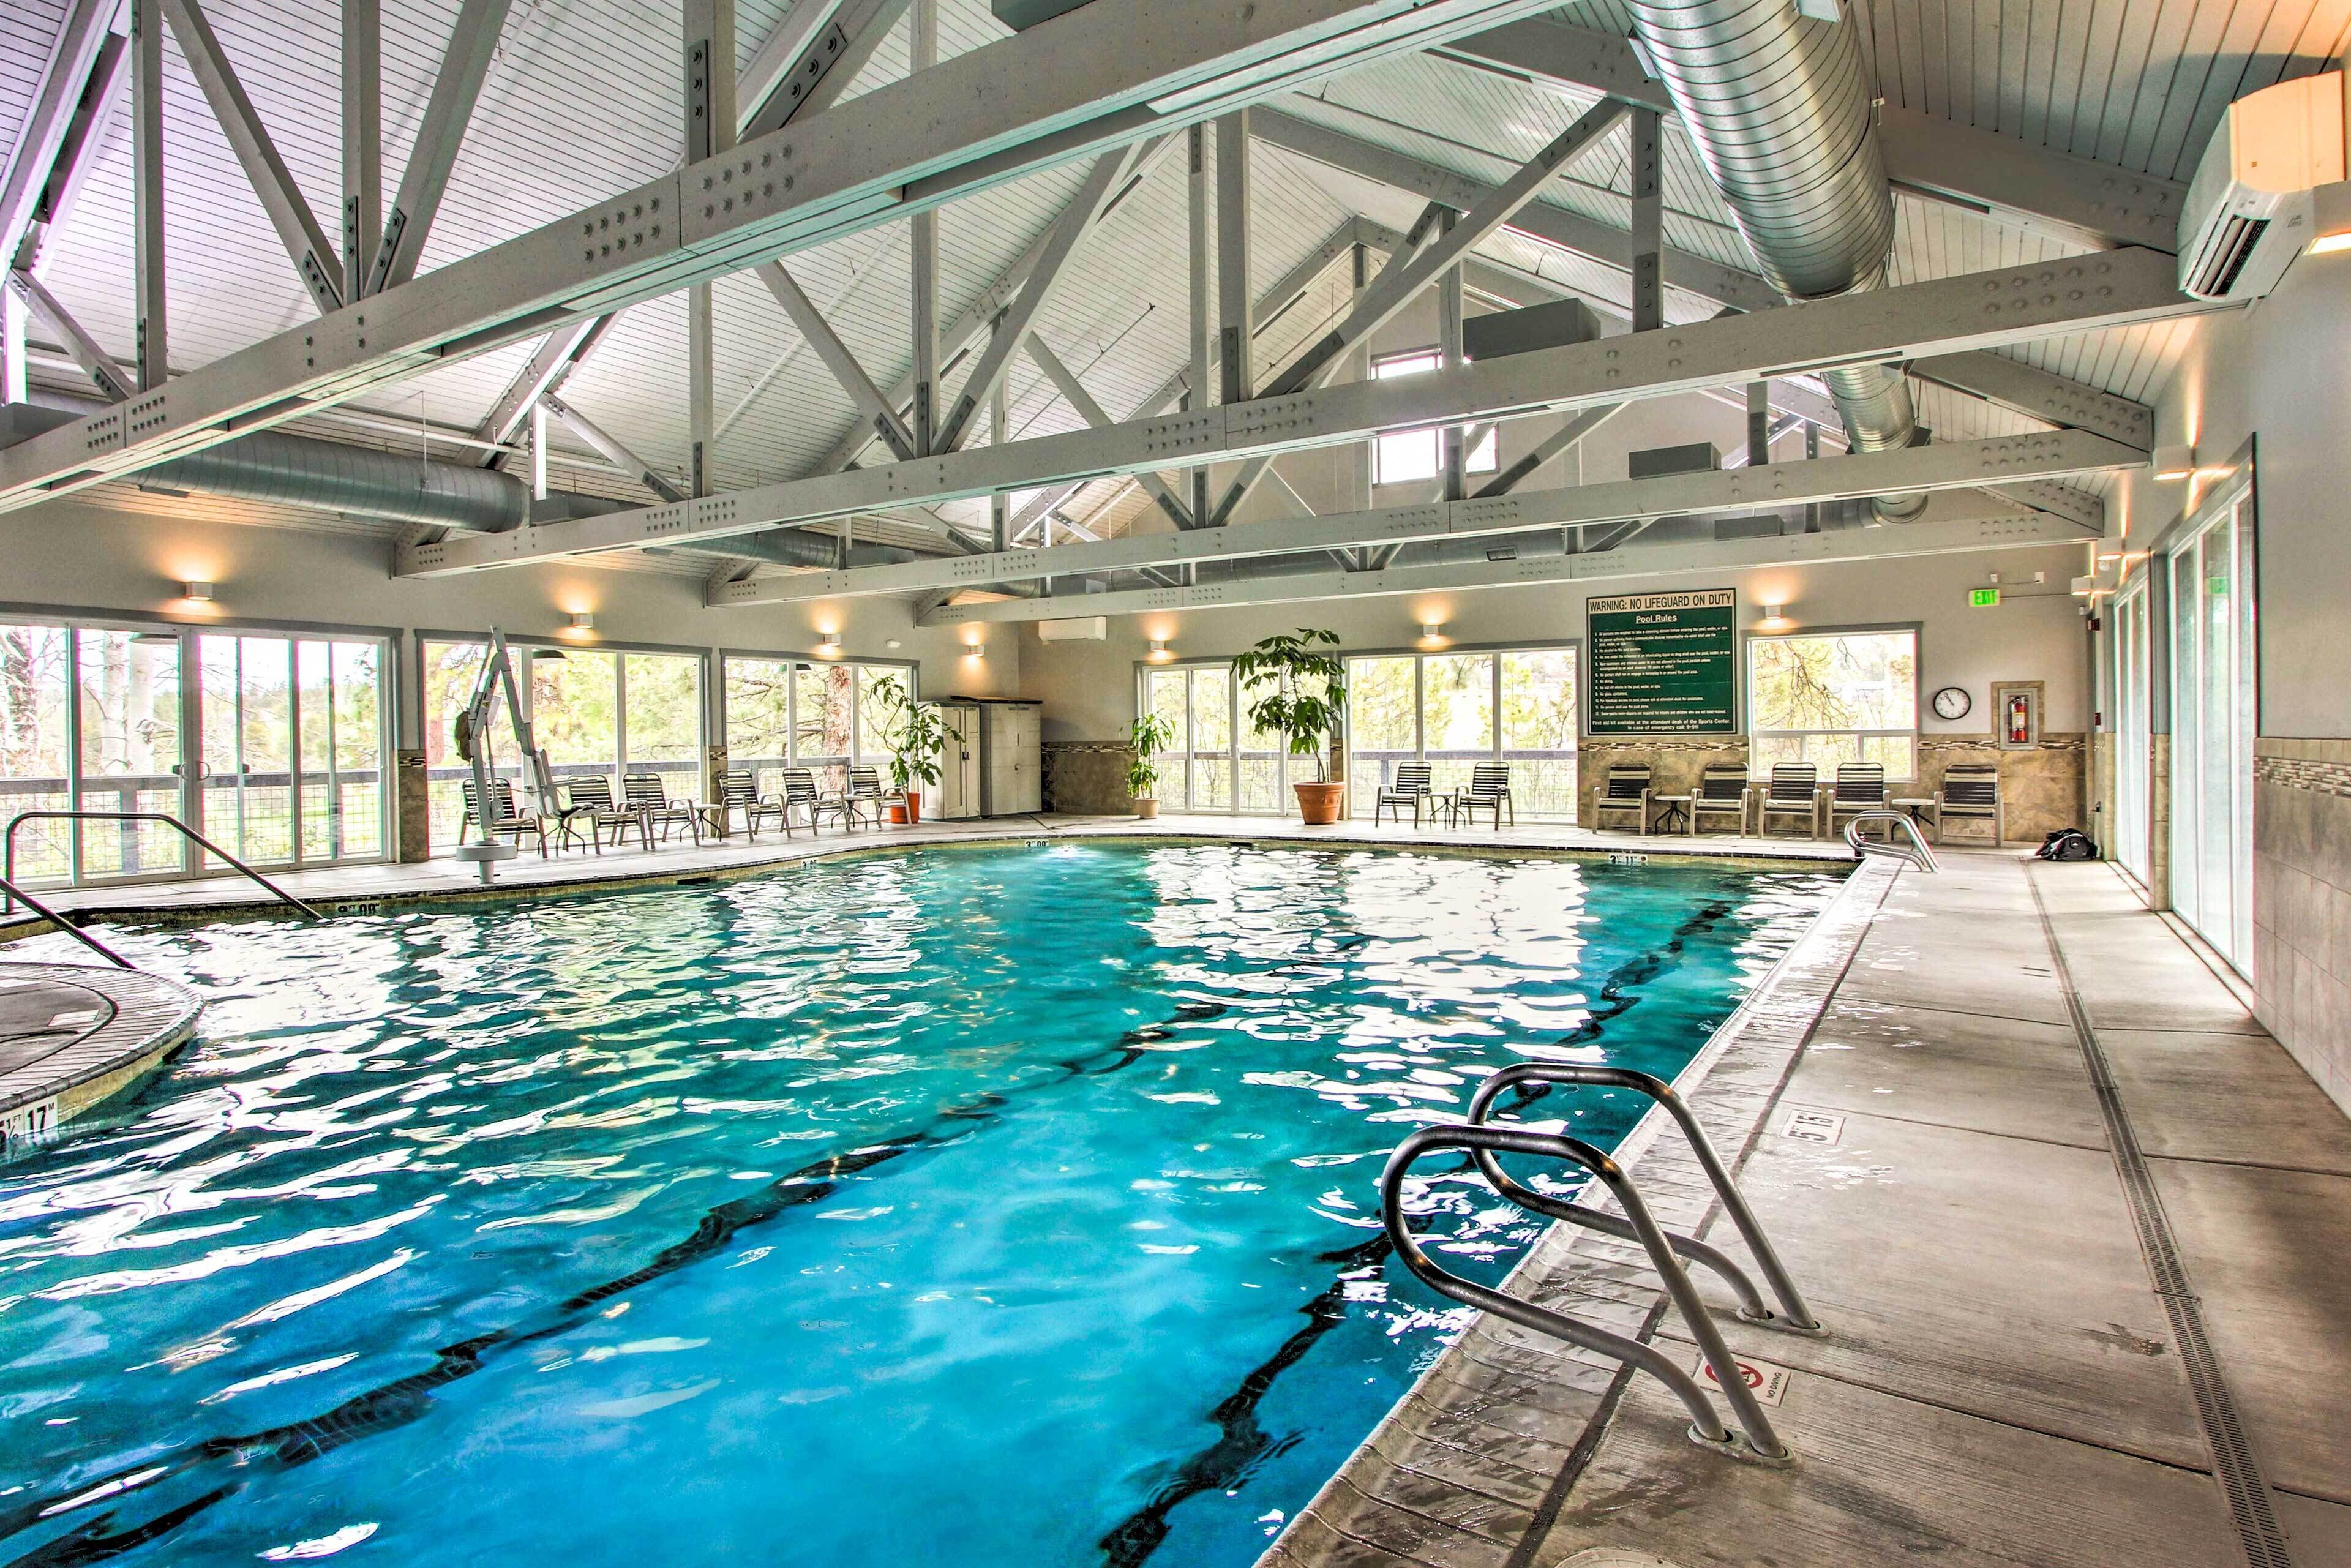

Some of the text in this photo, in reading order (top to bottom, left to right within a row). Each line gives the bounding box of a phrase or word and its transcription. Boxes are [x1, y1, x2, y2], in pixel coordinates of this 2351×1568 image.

[1590, 593, 1731, 612] WARNING: NO LIFEGUARD ON DUTY
[1974, 590, 1997, 606] EXIT
[1766, 1372, 1782, 1399] NO DIVING
